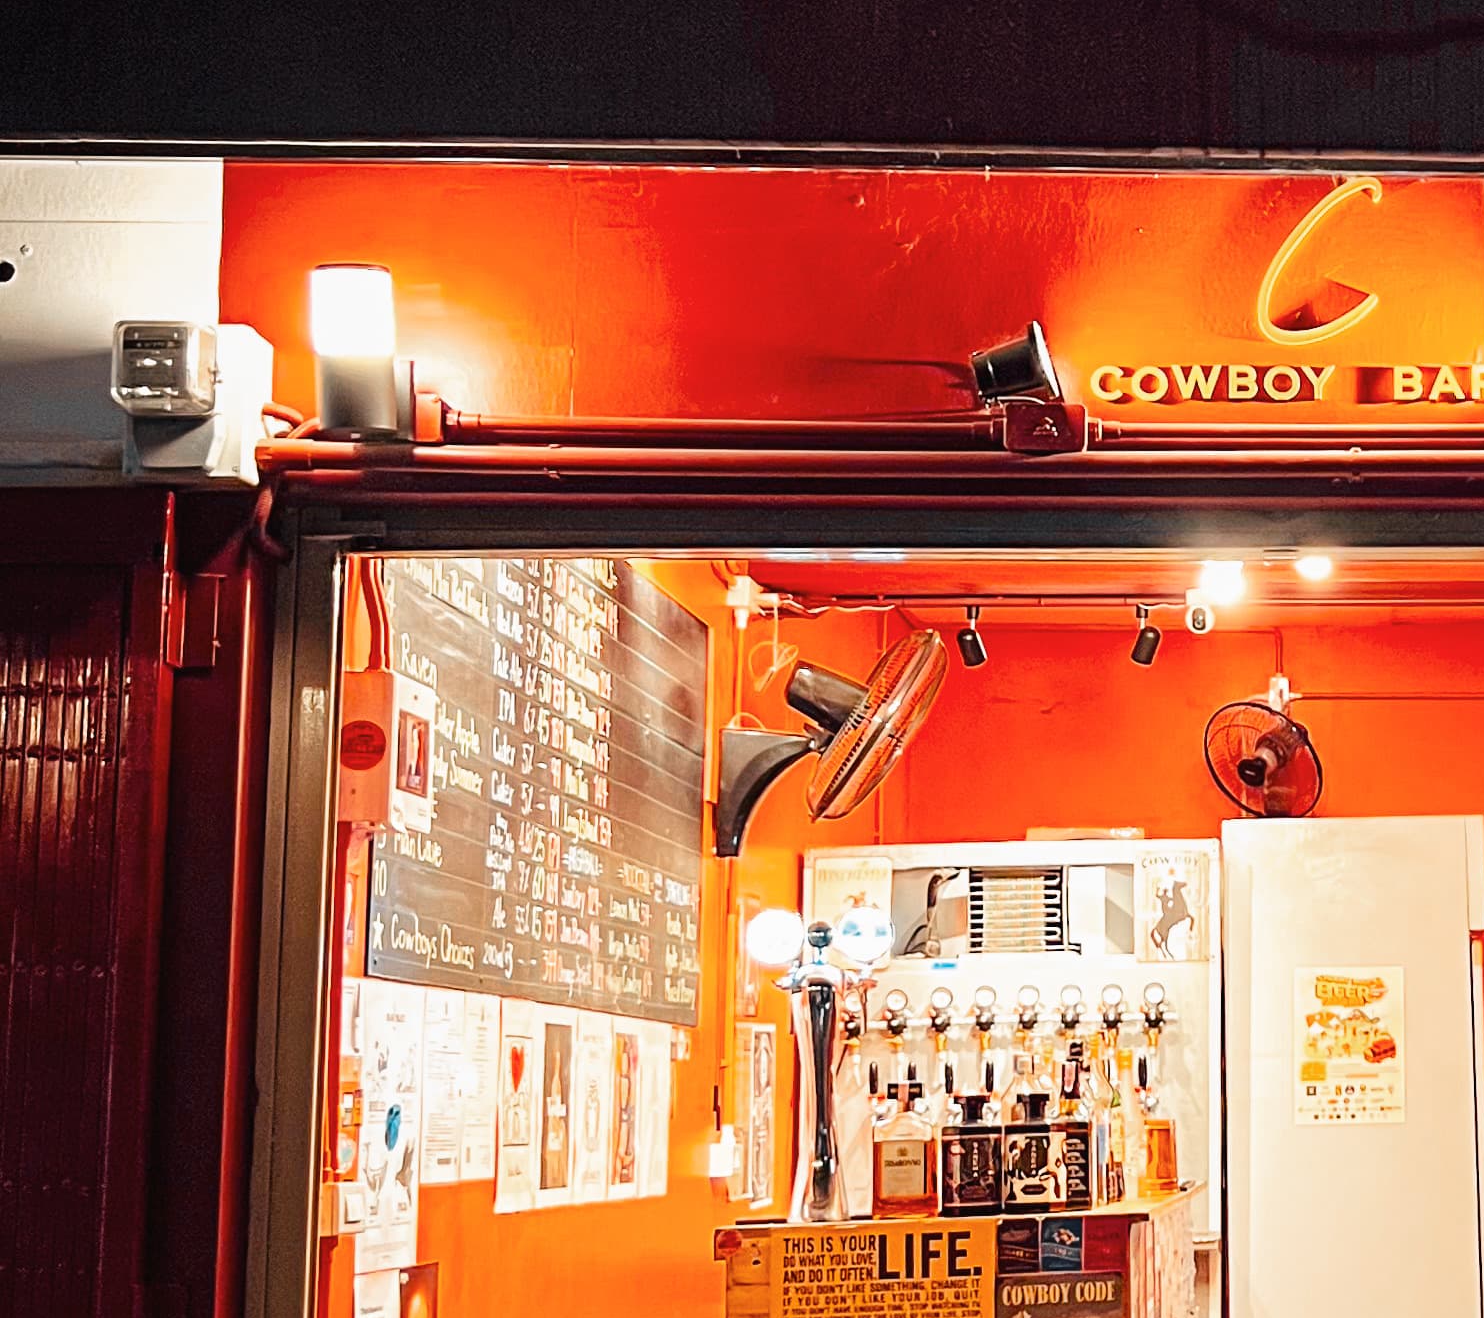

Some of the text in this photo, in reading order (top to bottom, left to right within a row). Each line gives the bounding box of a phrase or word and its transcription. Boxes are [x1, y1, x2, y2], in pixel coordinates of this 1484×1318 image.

[1090, 364, 1335, 402] COWBOY
[498, 688, 516, 726] IPA
[783, 1234, 877, 1254] THIS IS YOUR
[783, 1255, 796, 1268] DO
[799, 1254, 826, 1267] WHAT
[830, 1253, 848, 1266] YOU
[878, 1230, 983, 1280] LIFE.
[783, 1269, 806, 1284] AND
[809, 1268, 824, 1283] DO
[827, 1268, 836, 1282] IT
[794, 1285, 814, 1295] YOU
[798, 1296, 820, 1307] YOU
[862, 1293, 886, 1304] LIKE
[892, 1292, 921, 1303] YOUR
[1001, 1280, 1116, 1306] COWBOY CODE
